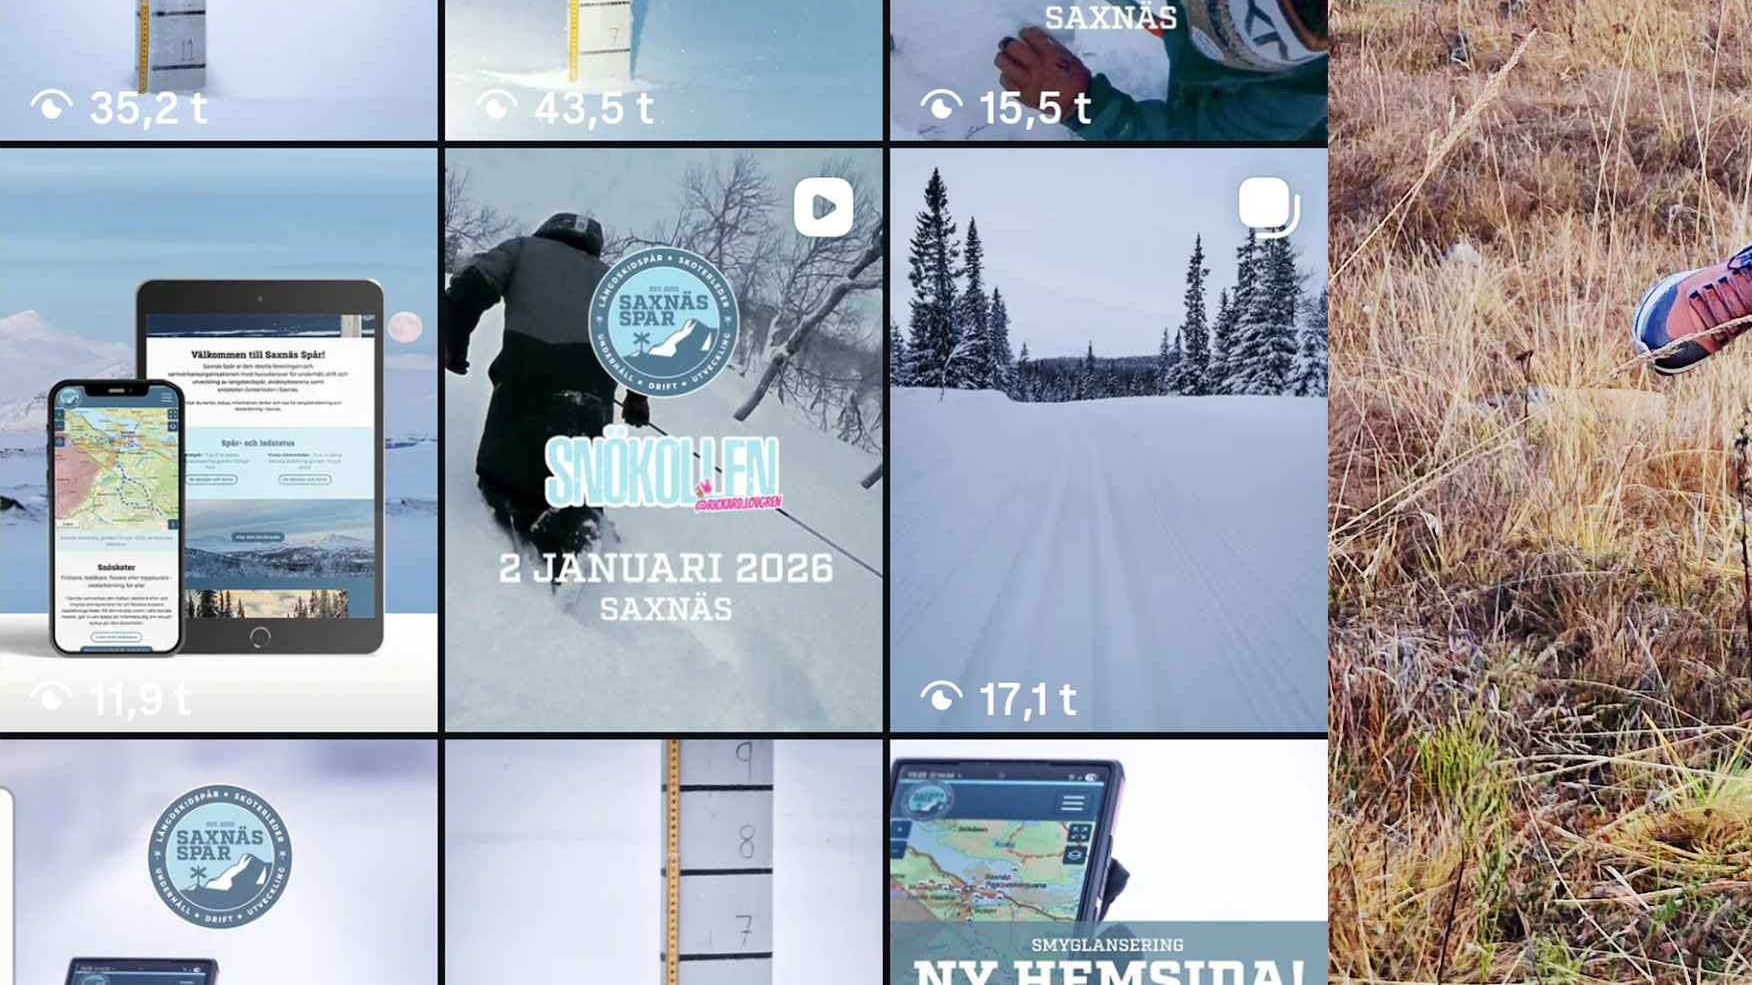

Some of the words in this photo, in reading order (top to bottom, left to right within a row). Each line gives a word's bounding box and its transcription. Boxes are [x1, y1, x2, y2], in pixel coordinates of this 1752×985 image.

[1046, 0, 1177, 30] SAXNÄS
[609, 27, 619, 47] 7
[90, 91, 179, 130] 35,2
[190, 93, 208, 125] t
[534, 91, 624, 130] 43,5
[636, 93, 654, 125] t
[980, 91, 1062, 130] 15,5
[1074, 93, 1092, 125] t
[678, 256, 729, 308] SKOTERLEDER
[619, 291, 709, 310] SAXNÄS
[619, 306, 676, 326] SPÅR
[191, 350, 247, 360] Välkommen
[249, 350, 263, 359] till
[265, 350, 299, 359] Saxnäs
[300, 350, 326, 361] Spår!
[597, 334, 634, 382] UNDERHÅLL
[648, 382, 678, 390] DRIFT
[691, 332, 731, 383] UTVECKLING
[244, 439, 258, 447] och
[260, 439, 295, 447] ledstatus
[545, 425, 779, 508] SNÖKOLLEN
[500, 553, 521, 583] 2
[534, 553, 723, 583] JANUARI
[736, 553, 833, 583] 2026
[600, 592, 732, 621] SAXNÄS
[90, 682, 165, 721] 11,9
[175, 684, 192, 716] t
[980, 682, 1047, 721] 17,1
[1059, 684, 1077, 716] t
[735, 741, 753, 781] 9
[234, 793, 284, 843] SKOTERLEDER
[177, 826, 263, 845] SAXNÄS
[177, 841, 231, 860] SPÅR
[740, 824, 755, 859] 8
[155, 867, 191, 915] UNDERHÅLL
[205, 915, 233, 923] DRIFT
[247, 867, 285, 915] UTVECKLING
[736, 915, 753, 946] 7
[1032, 938, 1184, 952] SMYGLANSERING
[914, 960, 998, 985] NY
